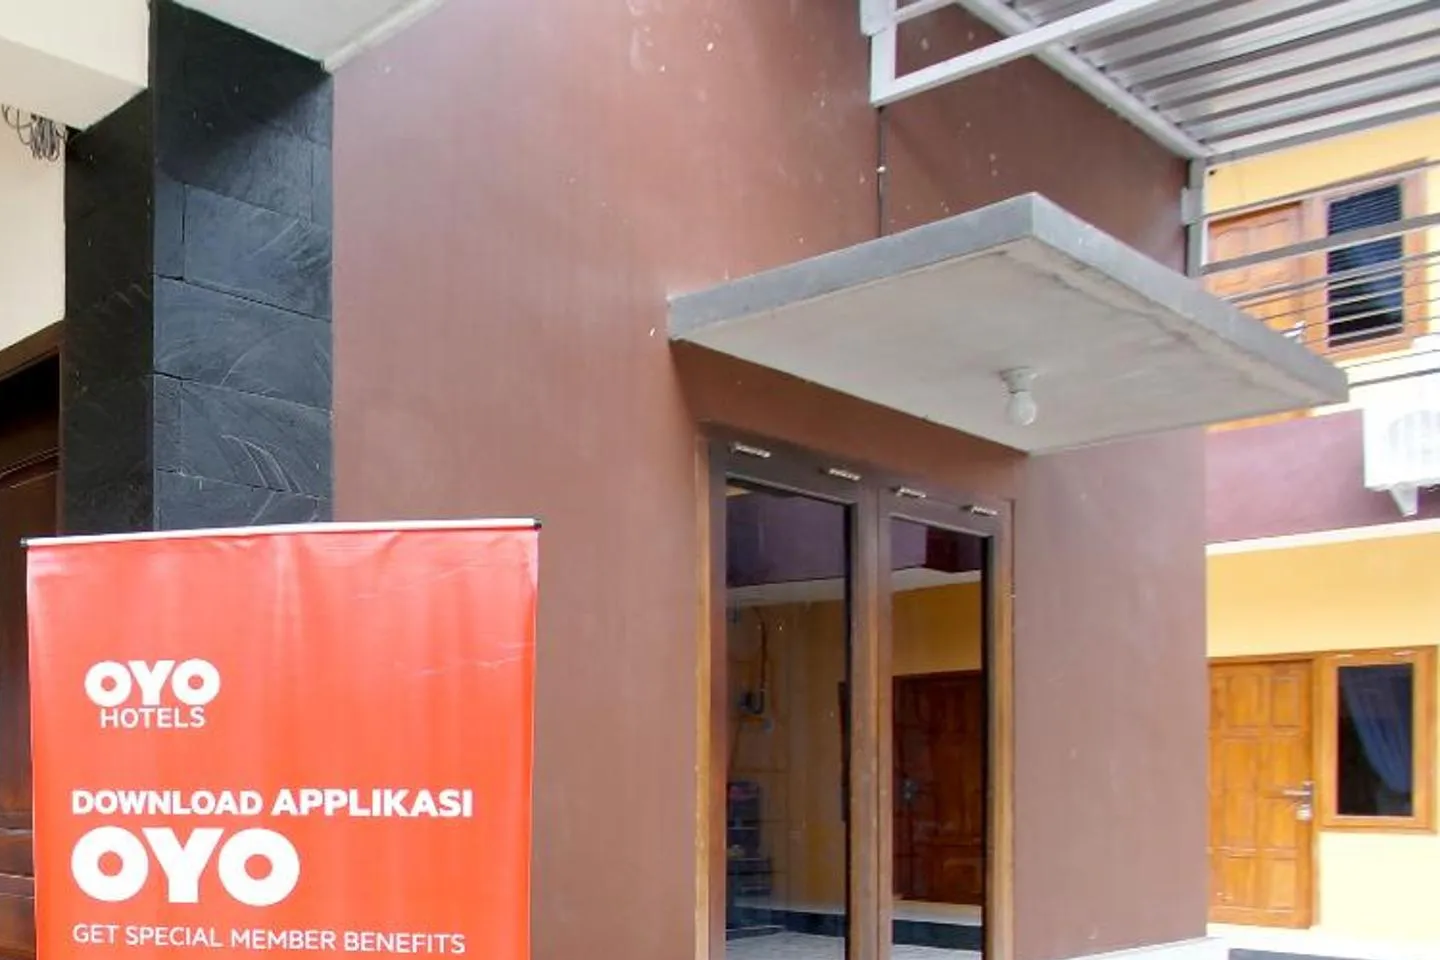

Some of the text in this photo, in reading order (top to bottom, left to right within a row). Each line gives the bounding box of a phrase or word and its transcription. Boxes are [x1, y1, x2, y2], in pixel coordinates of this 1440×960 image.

[84, 658, 221, 707] OYO
[100, 706, 206, 729] HOTELS
[71, 788, 473, 818] DOWNLOAD APPLIKASI
[71, 825, 301, 907] OYO
[72, 924, 466, 955] GET SPECIAL MEMBER BENEFITS
